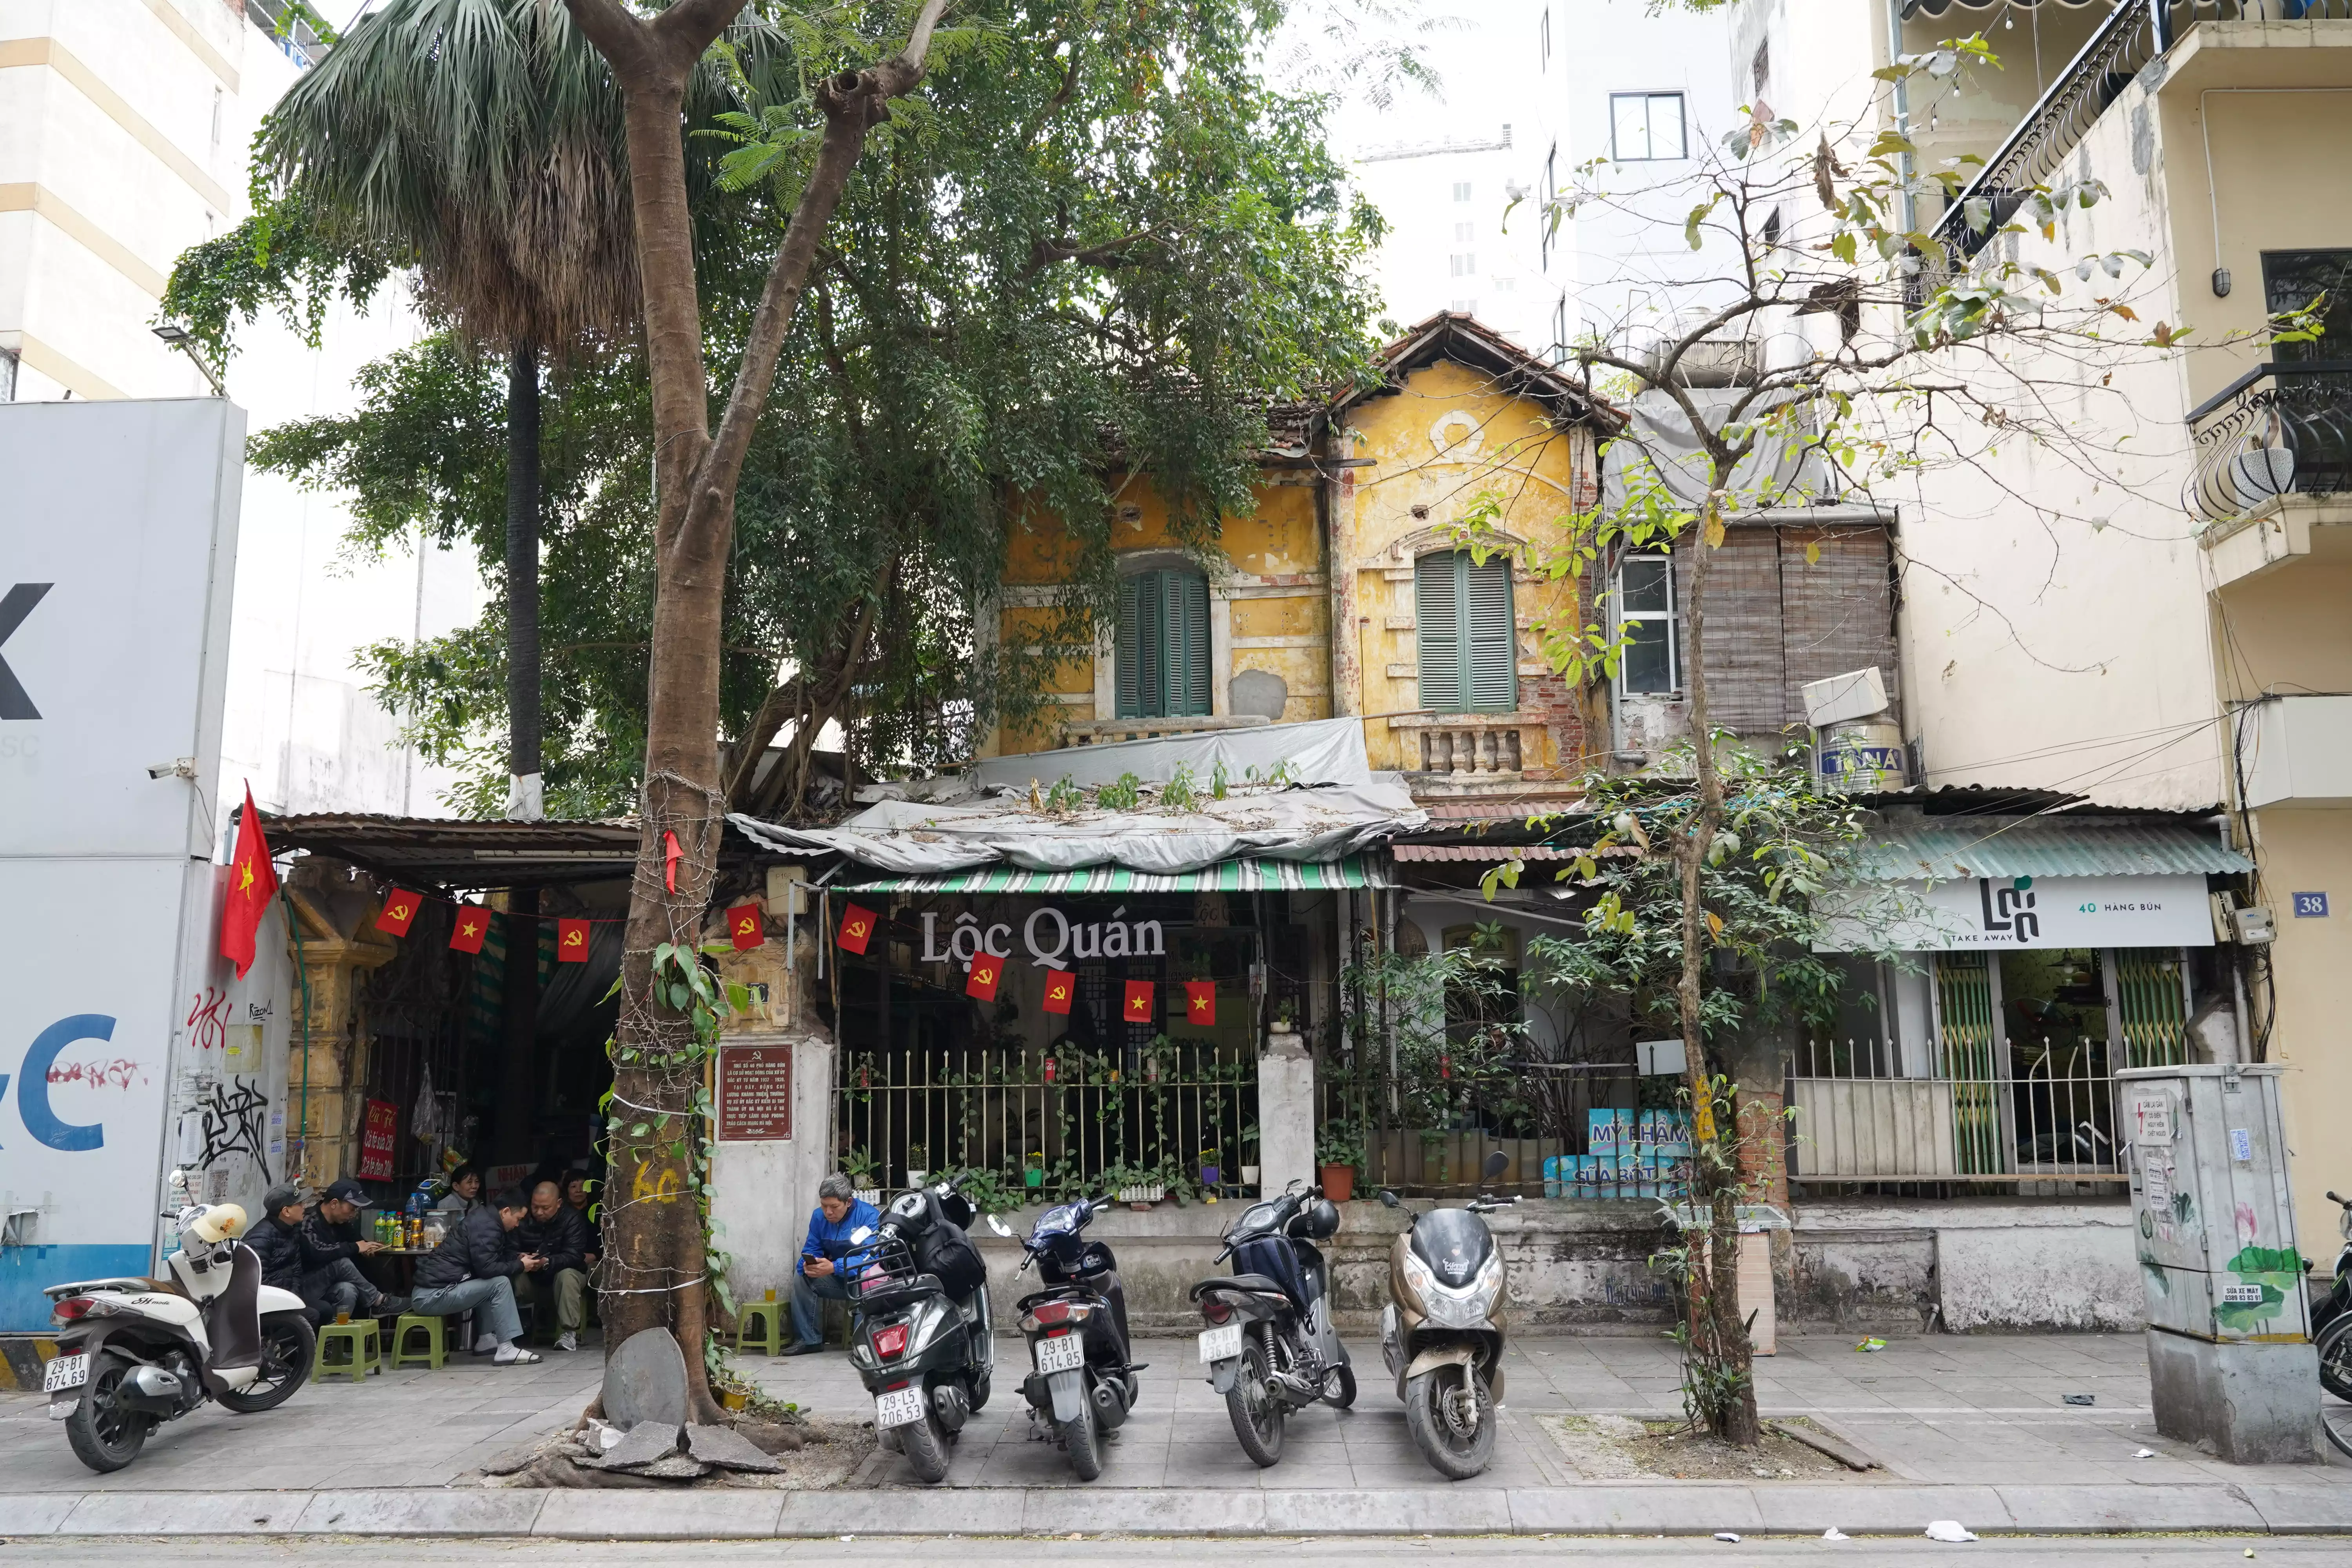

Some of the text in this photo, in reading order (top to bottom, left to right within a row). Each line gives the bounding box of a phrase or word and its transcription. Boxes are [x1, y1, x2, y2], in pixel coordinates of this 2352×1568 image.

[2079, 902, 2161, 913] 40 HÀNG BÚN
[2300, 897, 2323, 913] 38
[920, 904, 1166, 973] Lộc Quán
[1043, 1336, 1074, 1356] 29-B1
[1205, 1327, 1233, 1347] 29-H1
[1202, 1341, 1238, 1361] 236.60
[51, 1356, 83, 1376] 29-B1
[1041, 1351, 1080, 1372] 614.85
[46, 1370, 85, 1391] 874.69
[884, 1389, 915, 1411] 29-L5
[881, 1404, 920, 1426] 206.53
